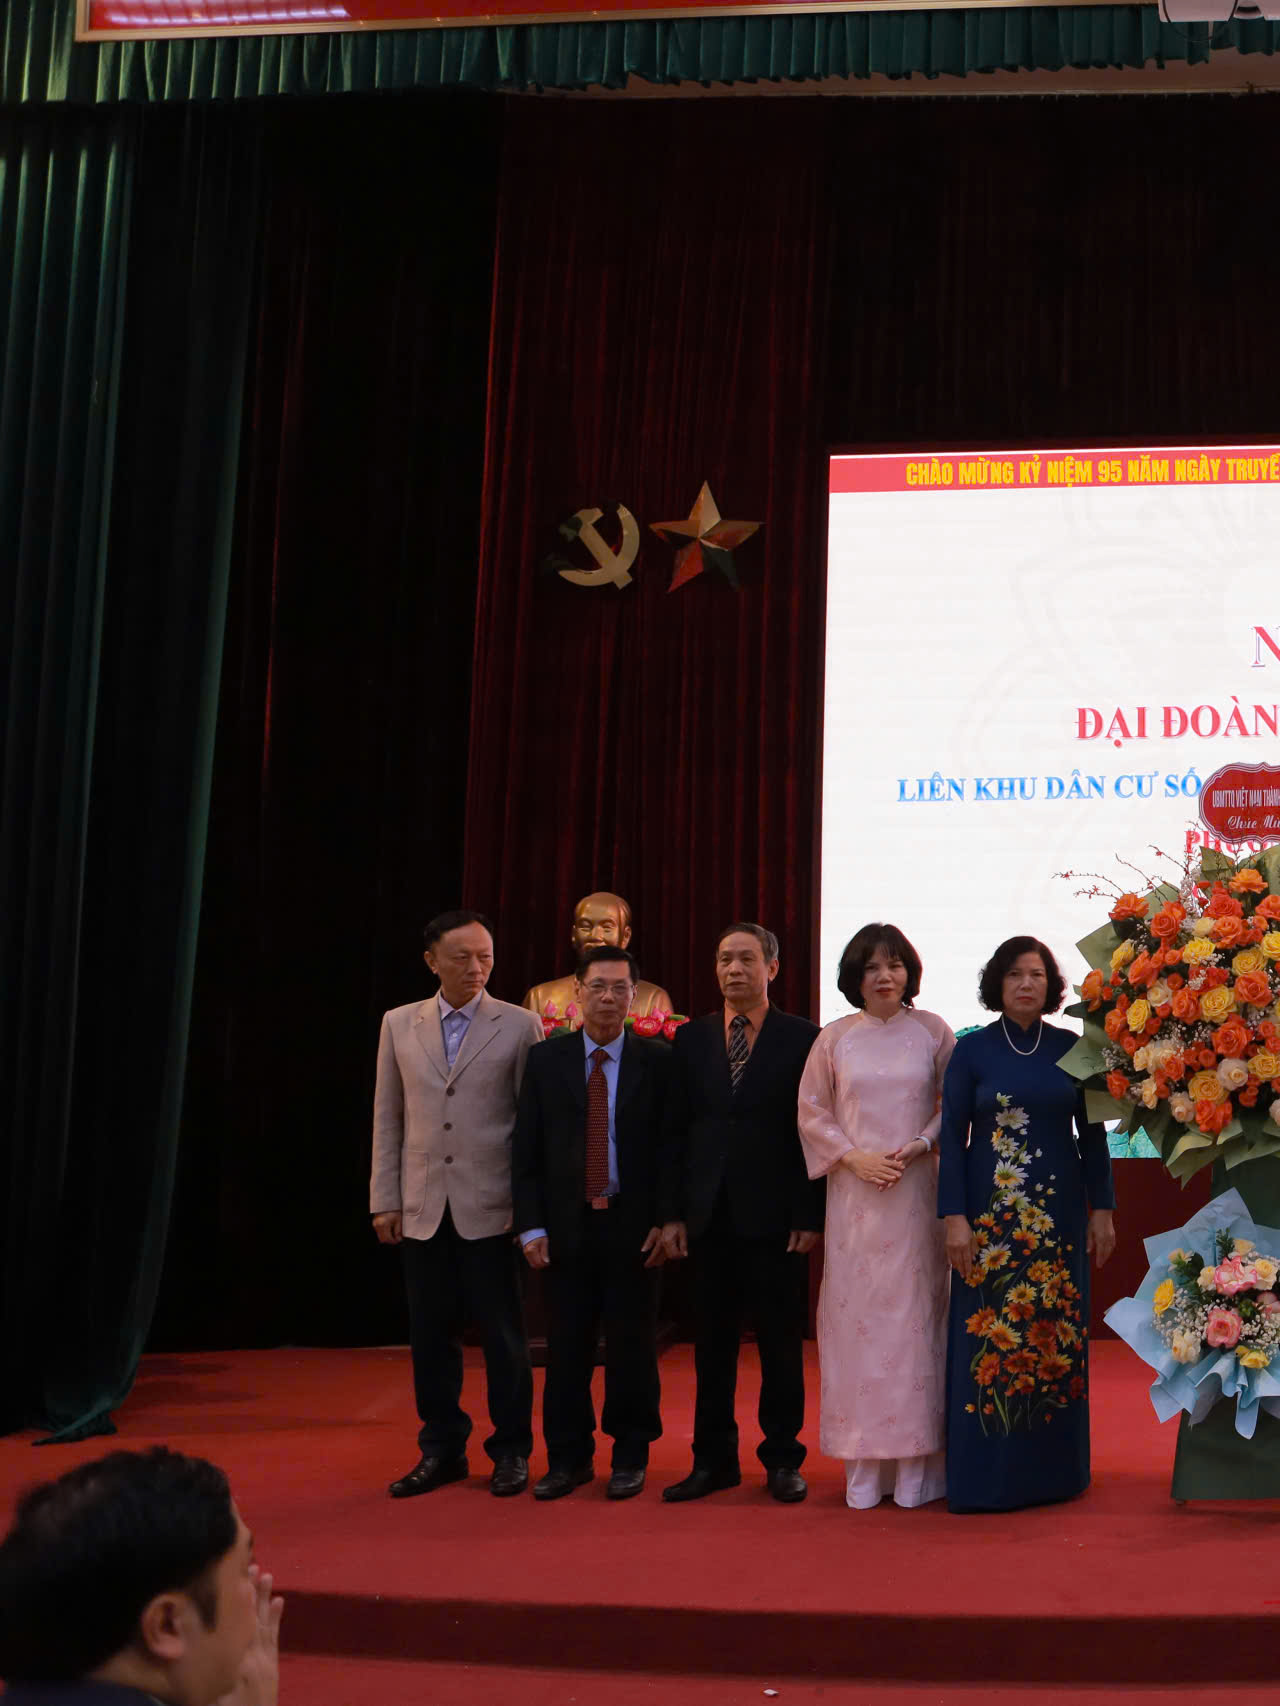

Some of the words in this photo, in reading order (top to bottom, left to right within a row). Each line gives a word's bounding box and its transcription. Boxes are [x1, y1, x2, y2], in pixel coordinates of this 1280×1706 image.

[905, 457, 954, 486] CHÀO
[958, 456, 1015, 485] MỪNG
[1046, 455, 1094, 488] NIỆM
[1097, 459, 1123, 483] 95
[1127, 455, 1170, 483] NĂM
[1175, 453, 1221, 482] NGÀY
[1076, 706, 1148, 748] ĐẠI
[1161, 695, 1279, 739] ĐOÀN
[895, 772, 965, 803] LIÊN
[975, 776, 1038, 801] KHU
[1045, 767, 1105, 800] DÂN
[1113, 771, 1159, 799] CƯ
[1164, 767, 1200, 798] SỐ
[1235, 785, 1249, 810] VIỆT
